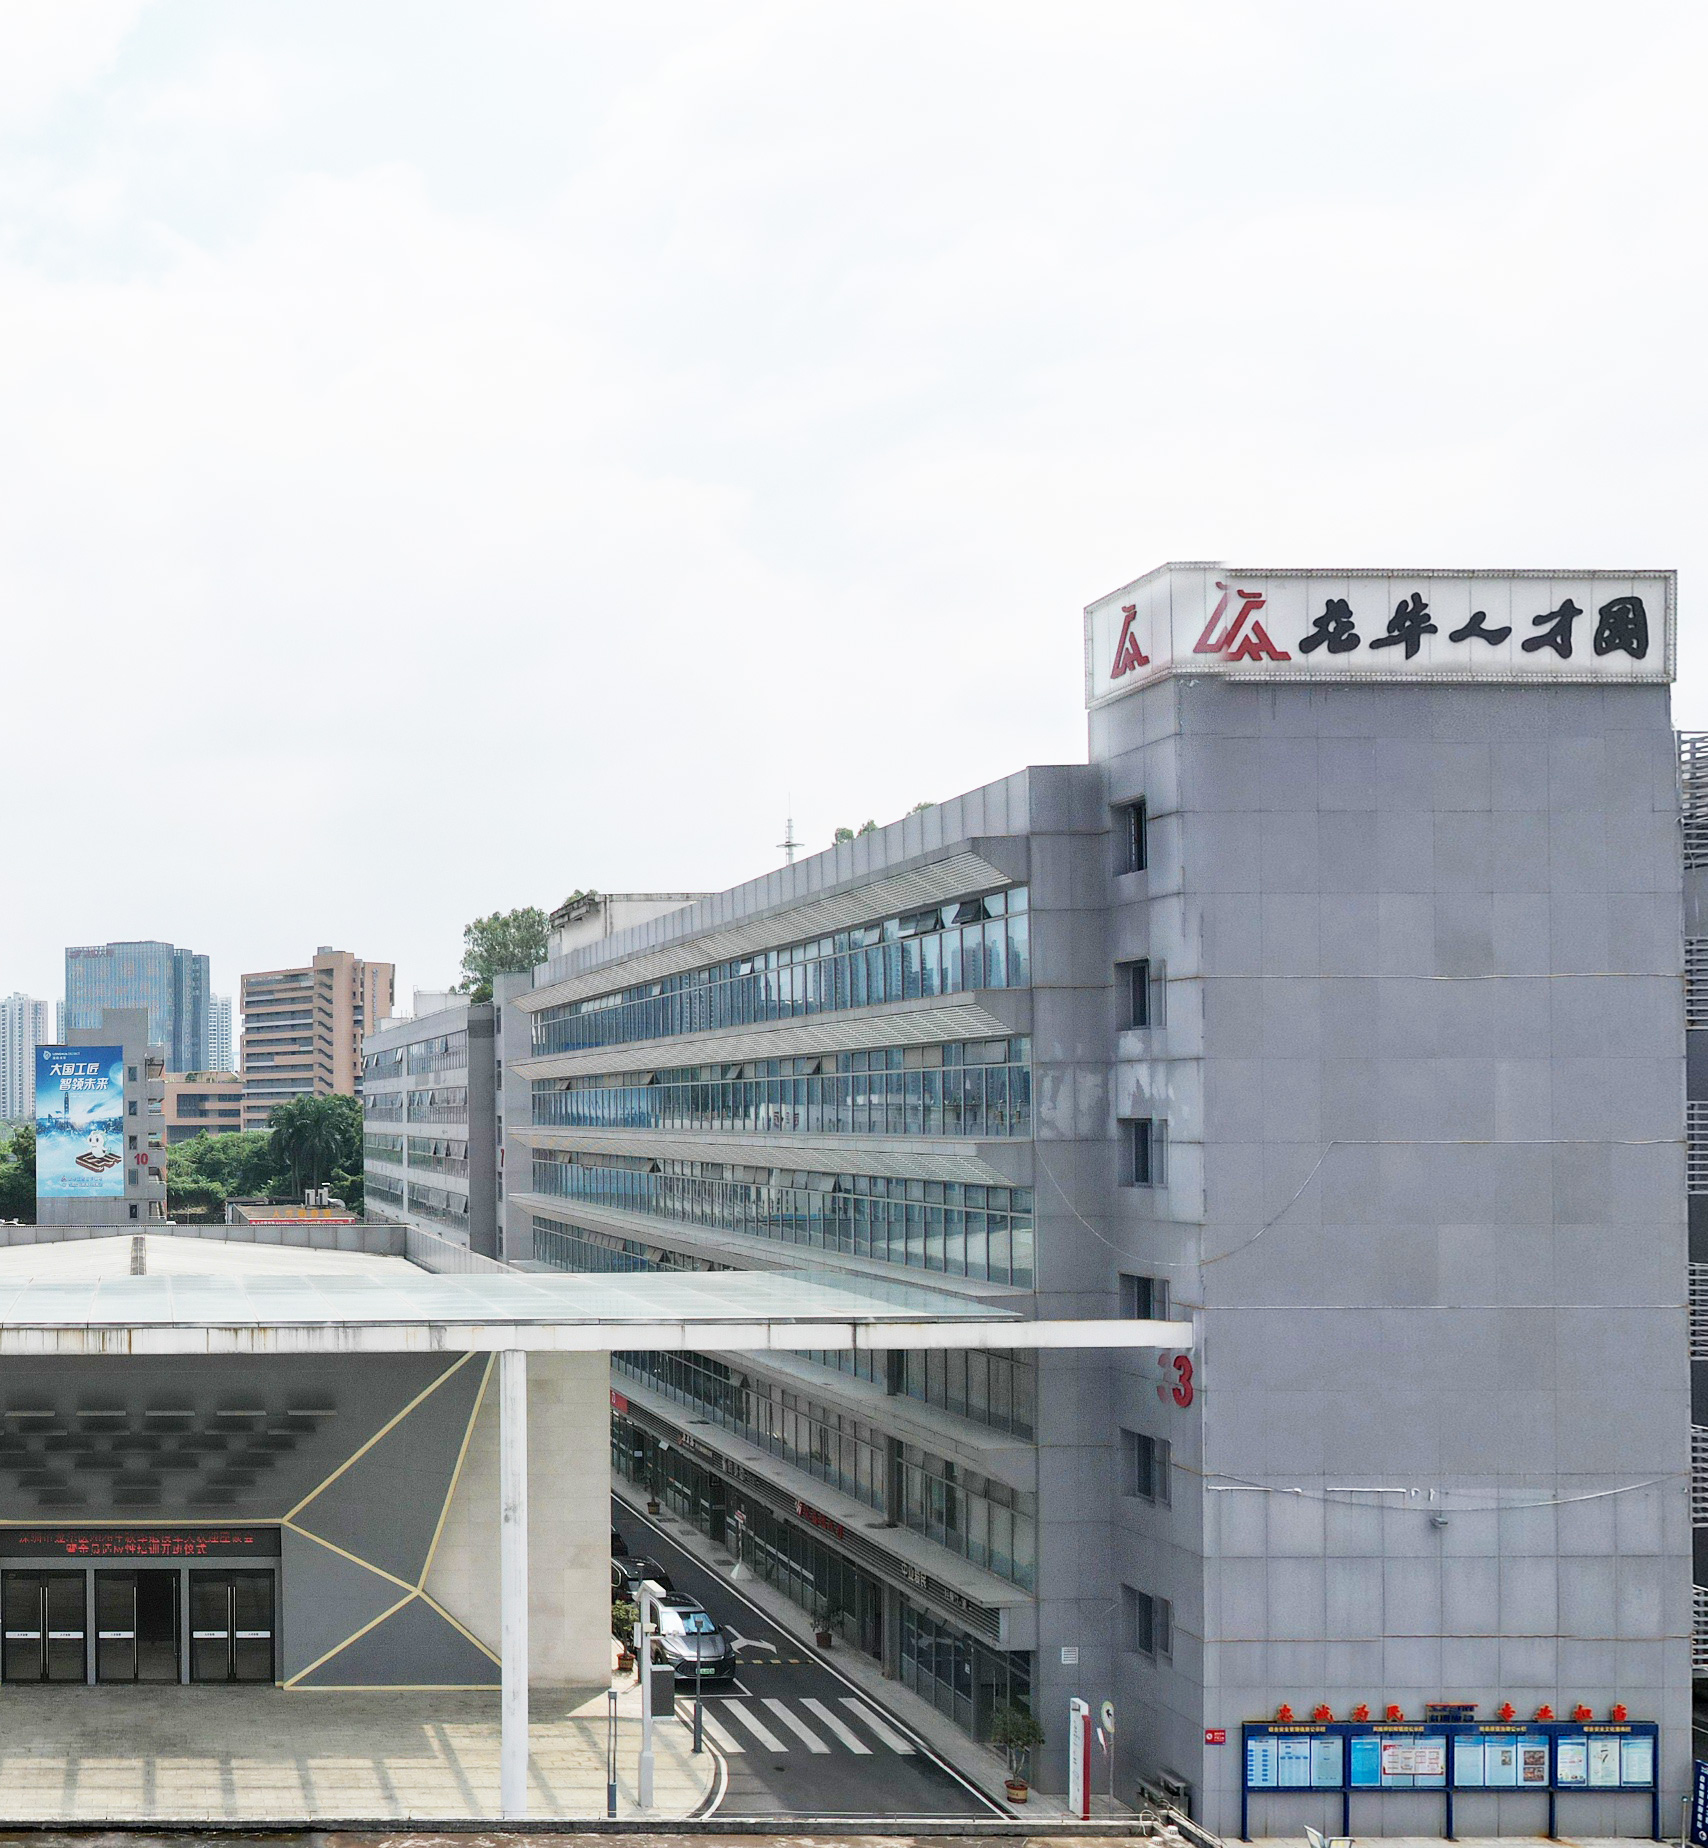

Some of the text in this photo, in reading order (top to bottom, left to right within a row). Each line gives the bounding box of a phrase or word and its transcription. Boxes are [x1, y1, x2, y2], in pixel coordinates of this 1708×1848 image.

[1298, 592, 1650, 660] 龙华人才园
[49, 1062, 100, 1076] 大国工匠
[59, 1077, 110, 1091] 智领未来
[134, 1153, 149, 1165] 10
[1172, 1355, 1193, 1408] 3
